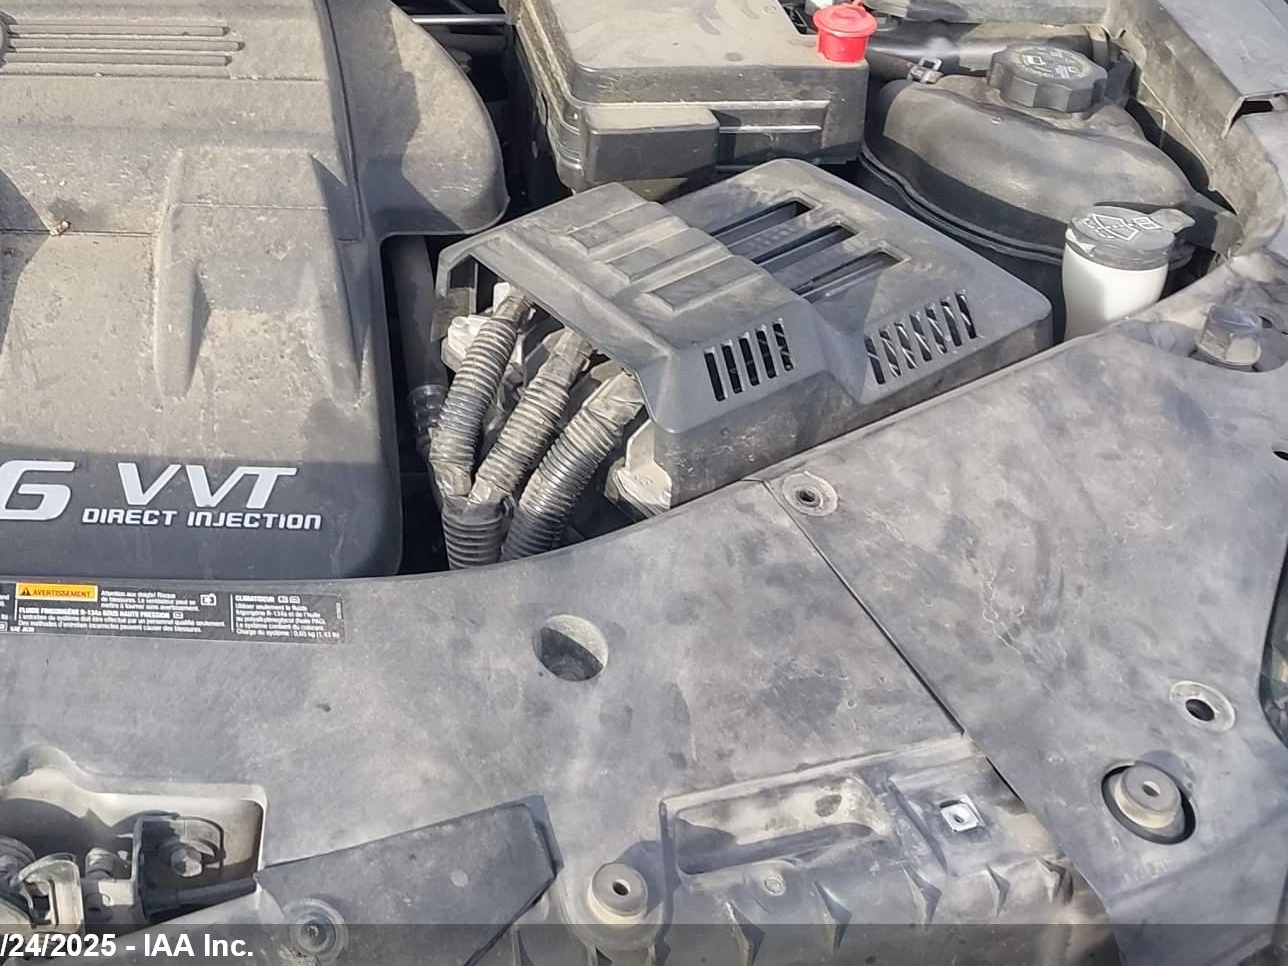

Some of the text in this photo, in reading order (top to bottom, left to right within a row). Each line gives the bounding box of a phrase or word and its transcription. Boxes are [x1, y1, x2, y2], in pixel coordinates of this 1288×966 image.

[117, 462, 298, 509] VVT
[82, 507, 323, 530] DIRECT INJECTION
[32, 590, 90, 598] AVERTISSEMENT
